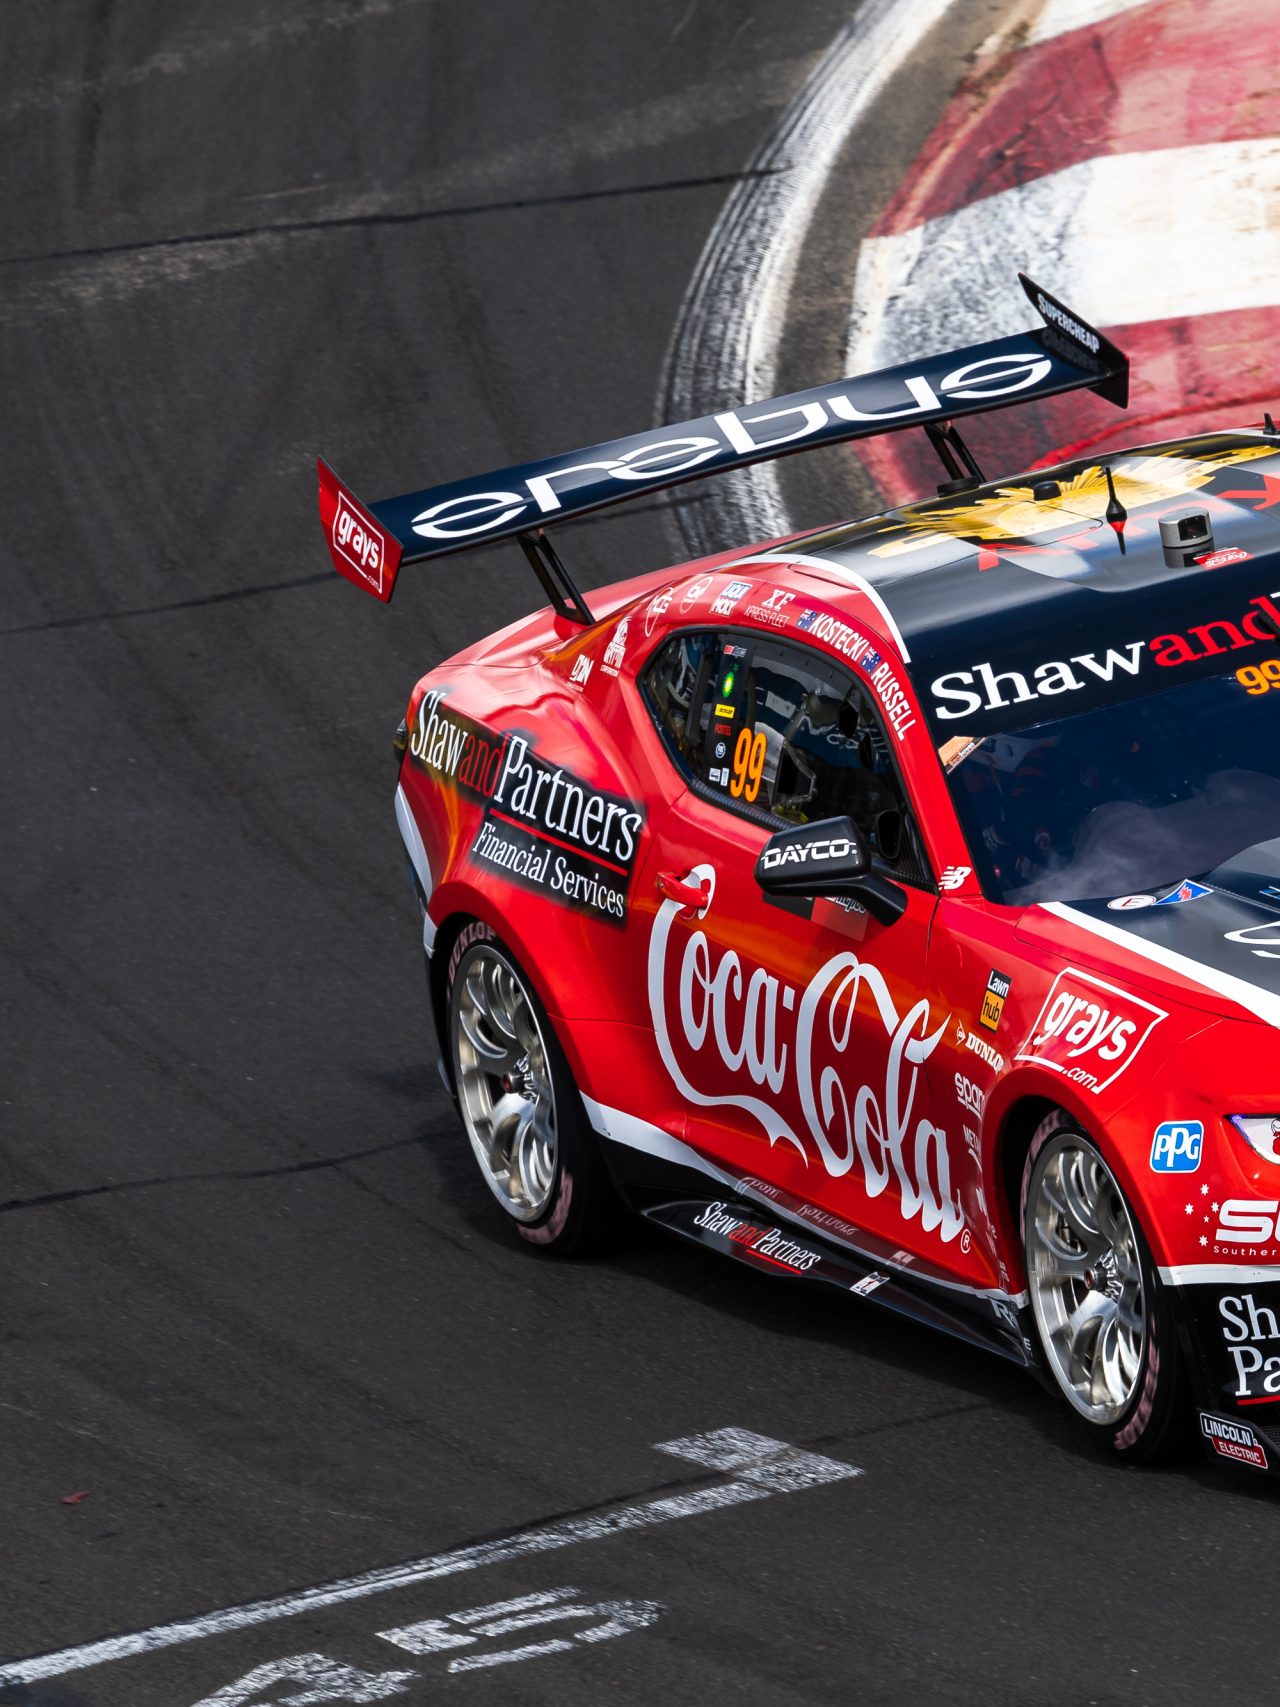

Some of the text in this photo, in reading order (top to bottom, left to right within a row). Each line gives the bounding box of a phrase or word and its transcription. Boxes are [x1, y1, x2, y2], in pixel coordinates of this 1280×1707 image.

[1037, 292, 1100, 354] SUPERCHEAP
[410, 352, 1053, 540] erebus
[337, 510, 380, 569] grays
[761, 589, 796, 611] XF
[767, 611, 790, 628] FLEET
[808, 612, 869, 661] KOSTECKI
[870, 662, 917, 741] RUSSELL
[730, 727, 767, 802] 99
[472, 822, 625, 918] Financial Services
[760, 839, 857, 870] DAYCO
[448, 921, 496, 983] DUNLOP
[987, 970, 1011, 997] Lawn
[983, 996, 1001, 1023] hub
[1033, 991, 1137, 1061] grays
[648, 863, 964, 1243] Coca-Cola
[965, 1031, 1005, 1074] DUNLOP
[1062, 1066, 1099, 1090] .com
[1154, 1127, 1201, 1168] PPG
[1202, 1417, 1253, 1446] LINCOLN
[1218, 1441, 1262, 1464] ELECTRIC
